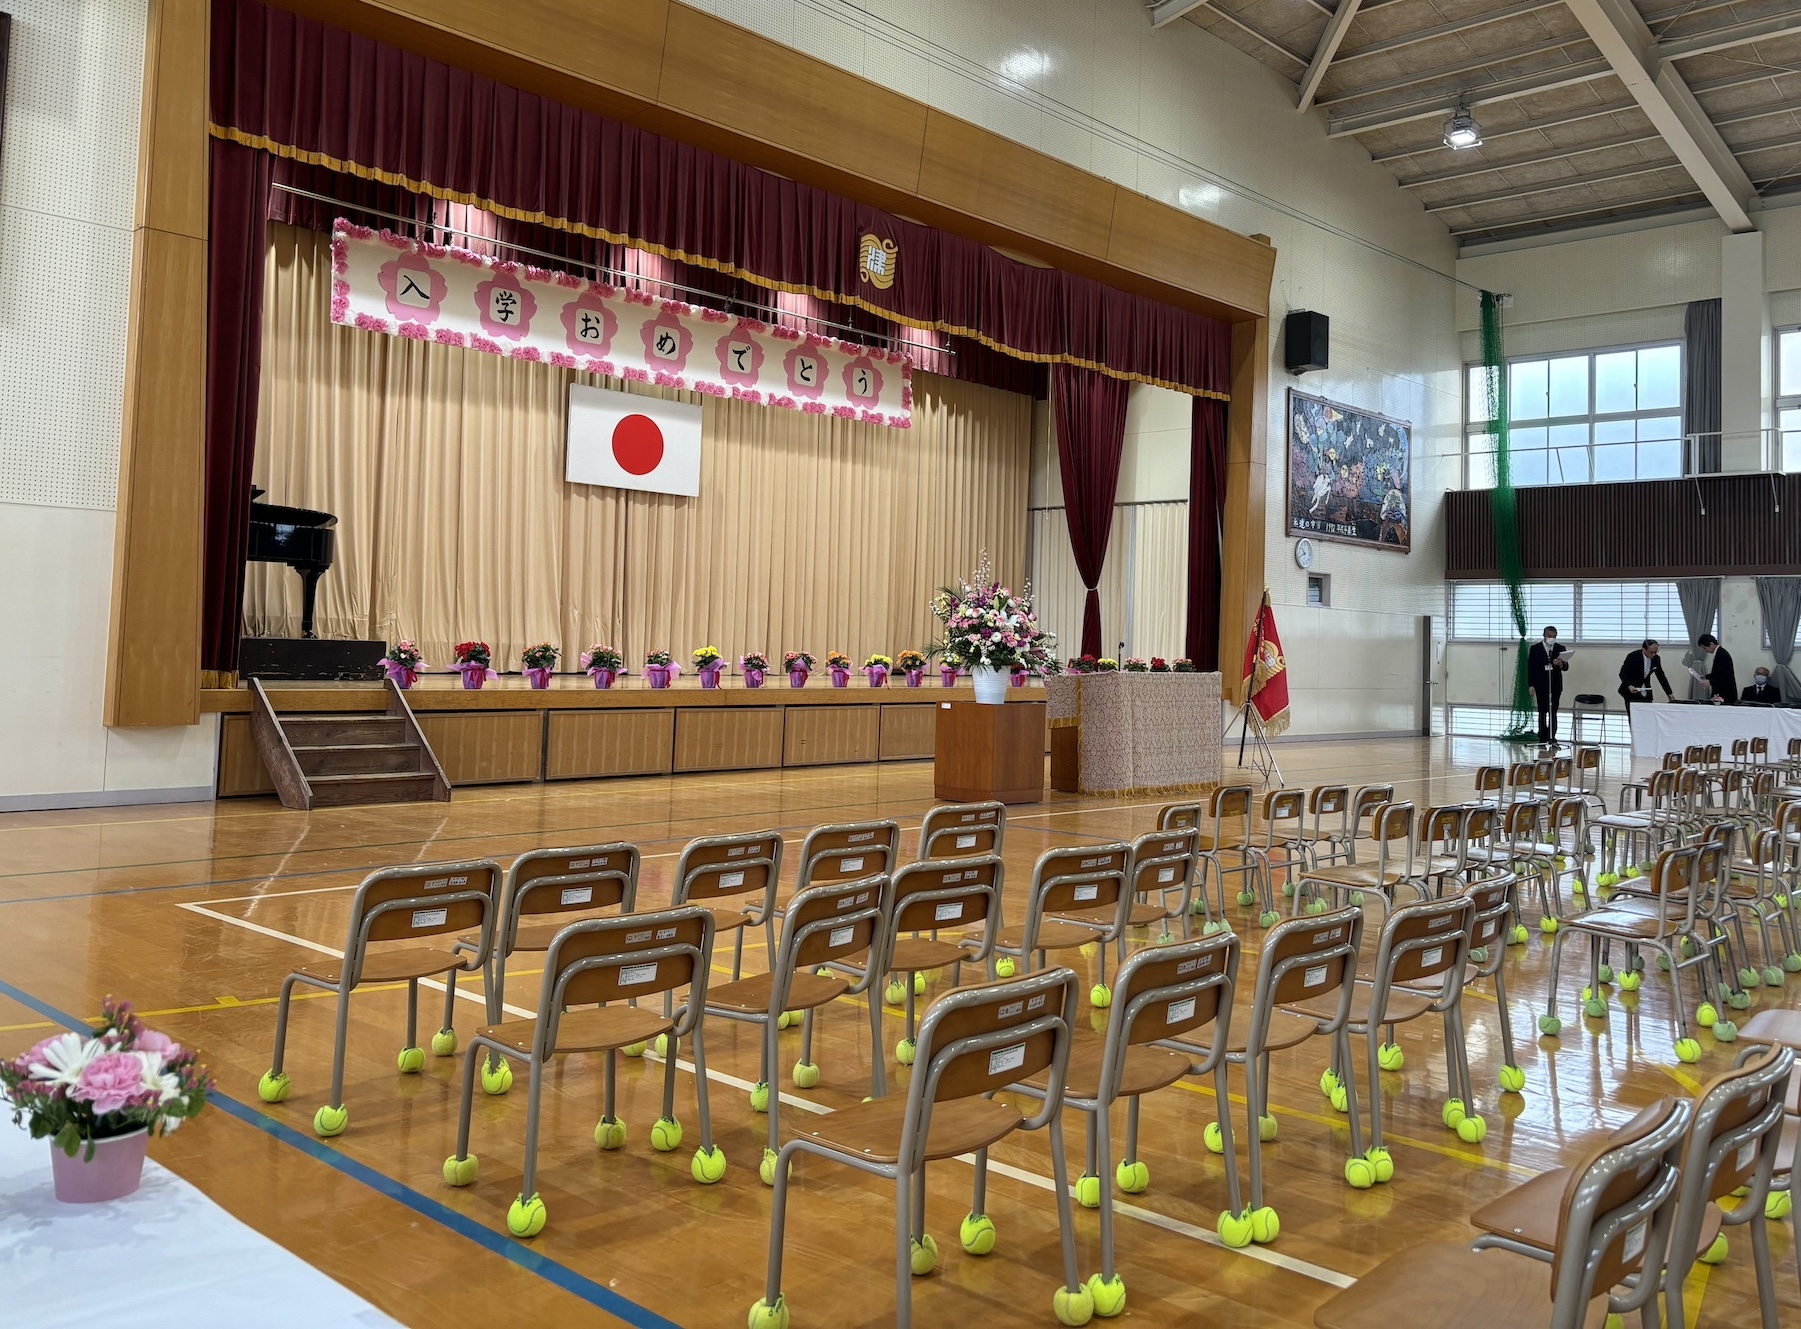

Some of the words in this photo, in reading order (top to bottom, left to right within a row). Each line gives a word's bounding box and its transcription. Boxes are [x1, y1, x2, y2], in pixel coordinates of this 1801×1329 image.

[400, 275, 867, 394] 入学おめでとう
